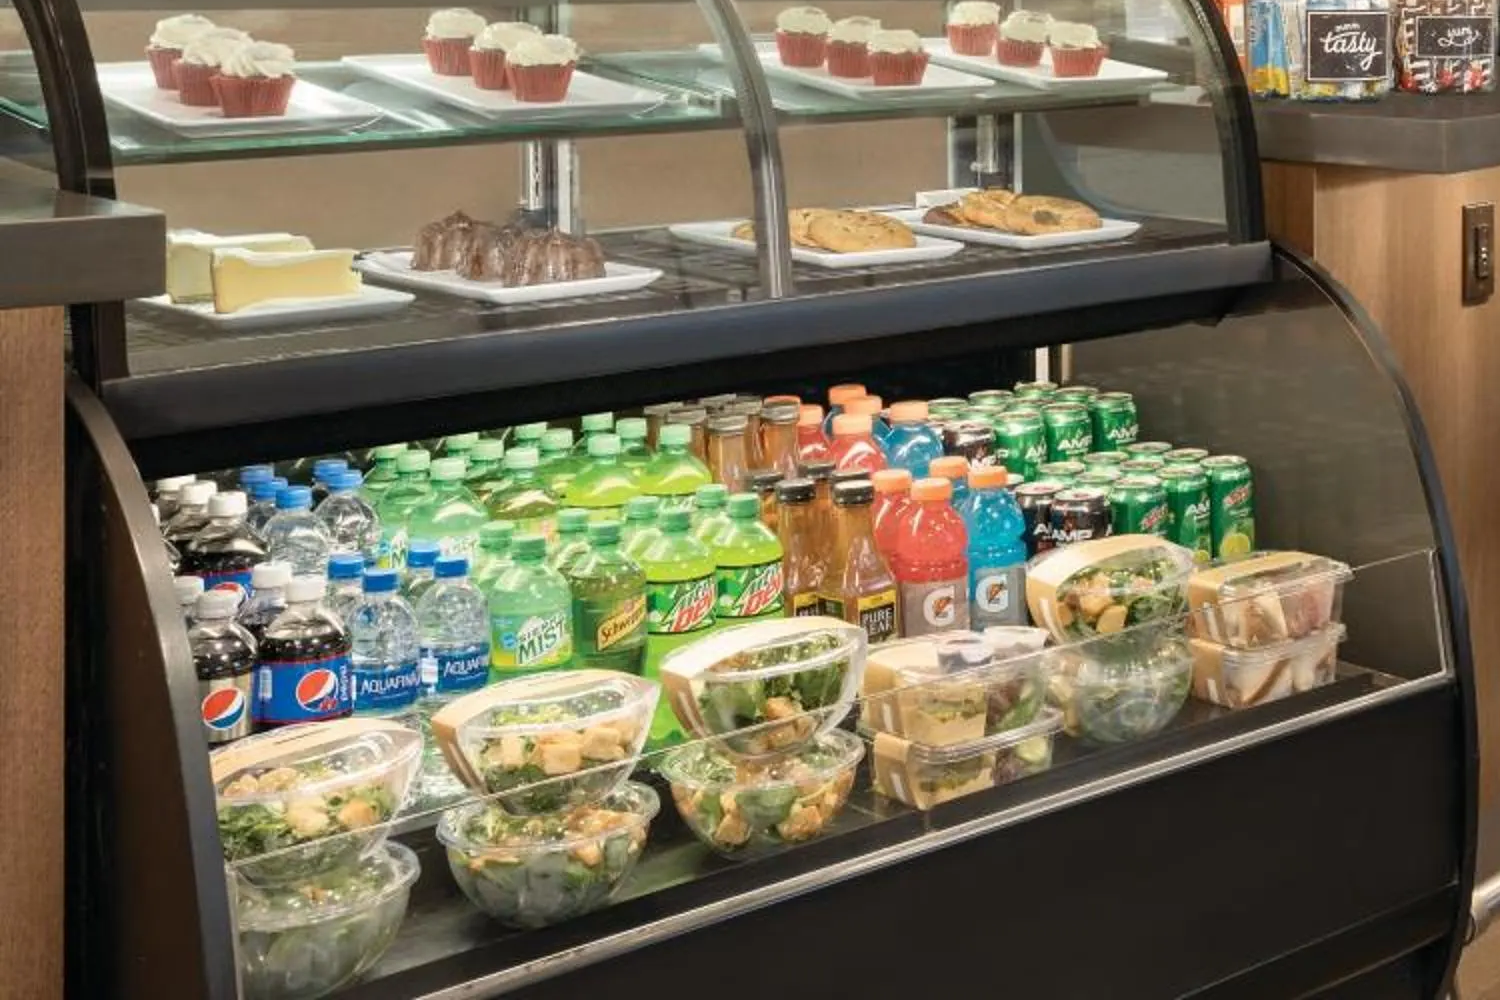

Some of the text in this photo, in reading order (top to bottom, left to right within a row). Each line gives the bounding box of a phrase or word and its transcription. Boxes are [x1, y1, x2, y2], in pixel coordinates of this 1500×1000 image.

[1319, 31, 1384, 71] tasty
[1052, 527, 1093, 543] AMP
[862, 606, 892, 625] PURE
[519, 620, 564, 665] MIST
